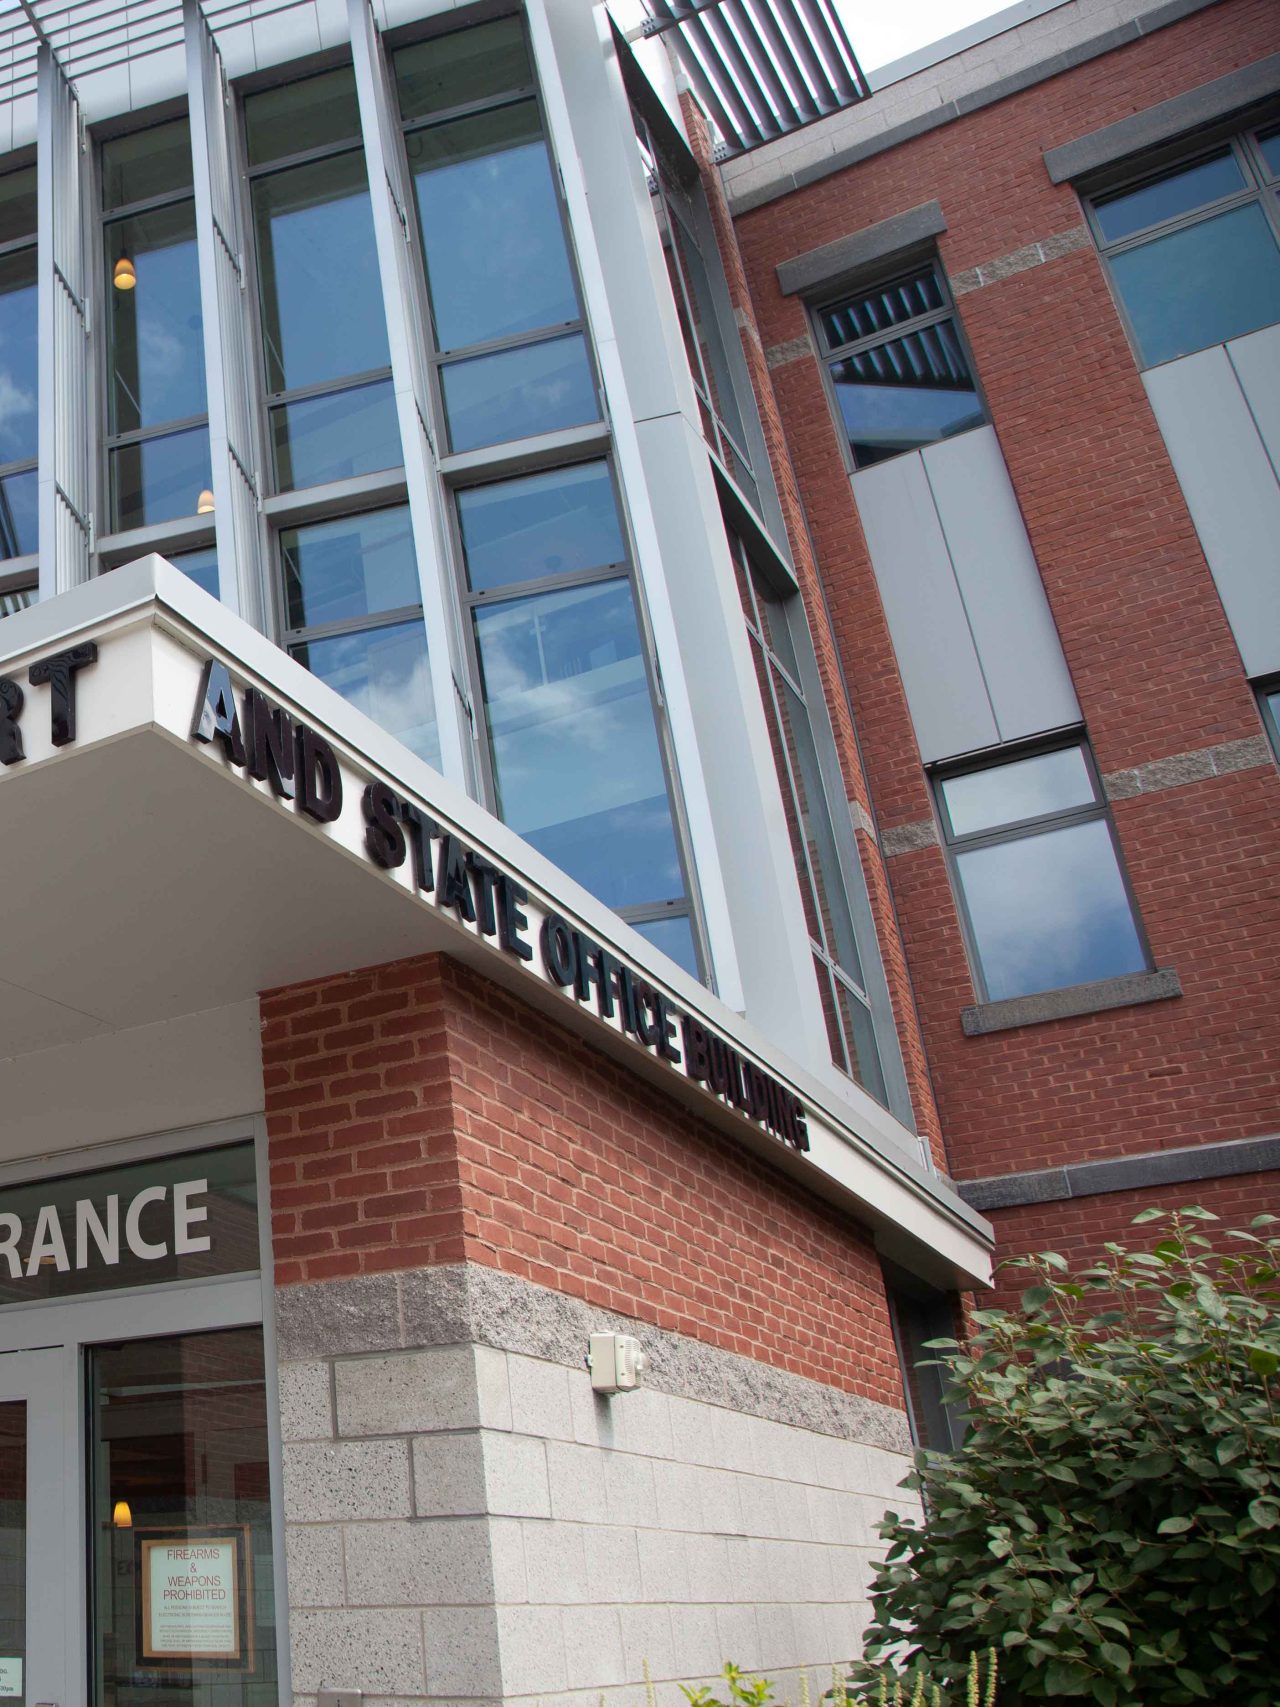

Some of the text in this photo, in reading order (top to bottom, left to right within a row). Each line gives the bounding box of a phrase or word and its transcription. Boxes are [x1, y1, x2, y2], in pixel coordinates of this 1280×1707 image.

[191, 658, 811, 1152] AND STATE OFFICE BUILDING
[167, 1548, 220, 1560] FIREARMS
[189, 1562, 197, 1573] &
[168, 1575, 221, 1587] WEAPONS
[163, 1588, 226, 1600] PROHIBITED
